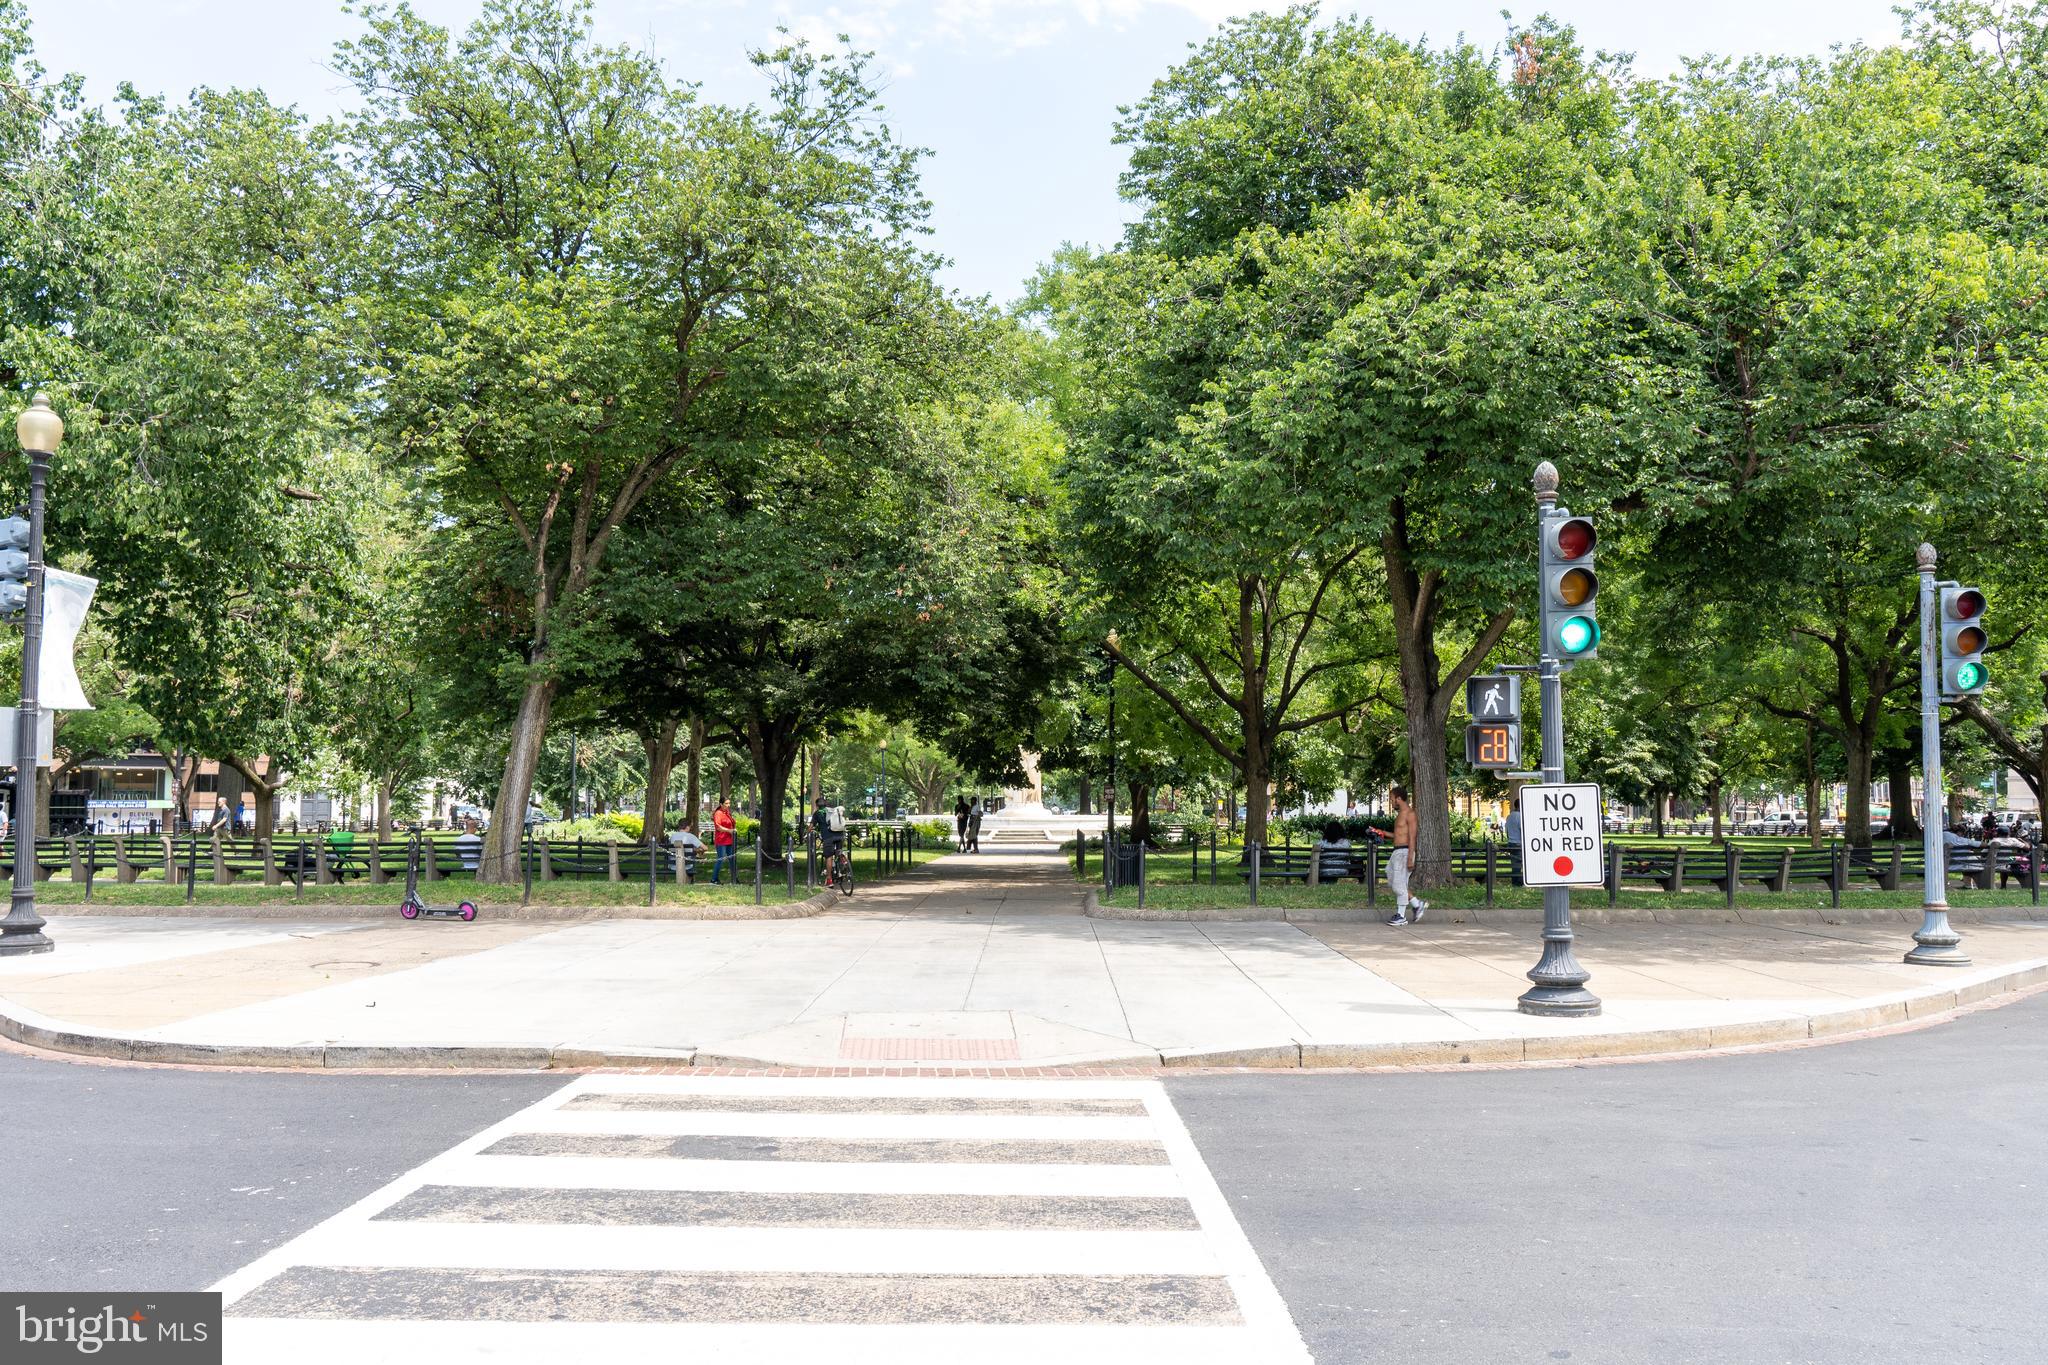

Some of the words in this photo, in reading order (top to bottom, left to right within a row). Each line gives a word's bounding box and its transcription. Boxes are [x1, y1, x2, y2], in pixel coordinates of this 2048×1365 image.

[1480, 730, 1507, 762] 28
[1543, 793, 1576, 812] NO
[1539, 816, 1584, 832] TURN
[1530, 837, 1553, 853] ON
[1562, 836, 1594, 852] RED
